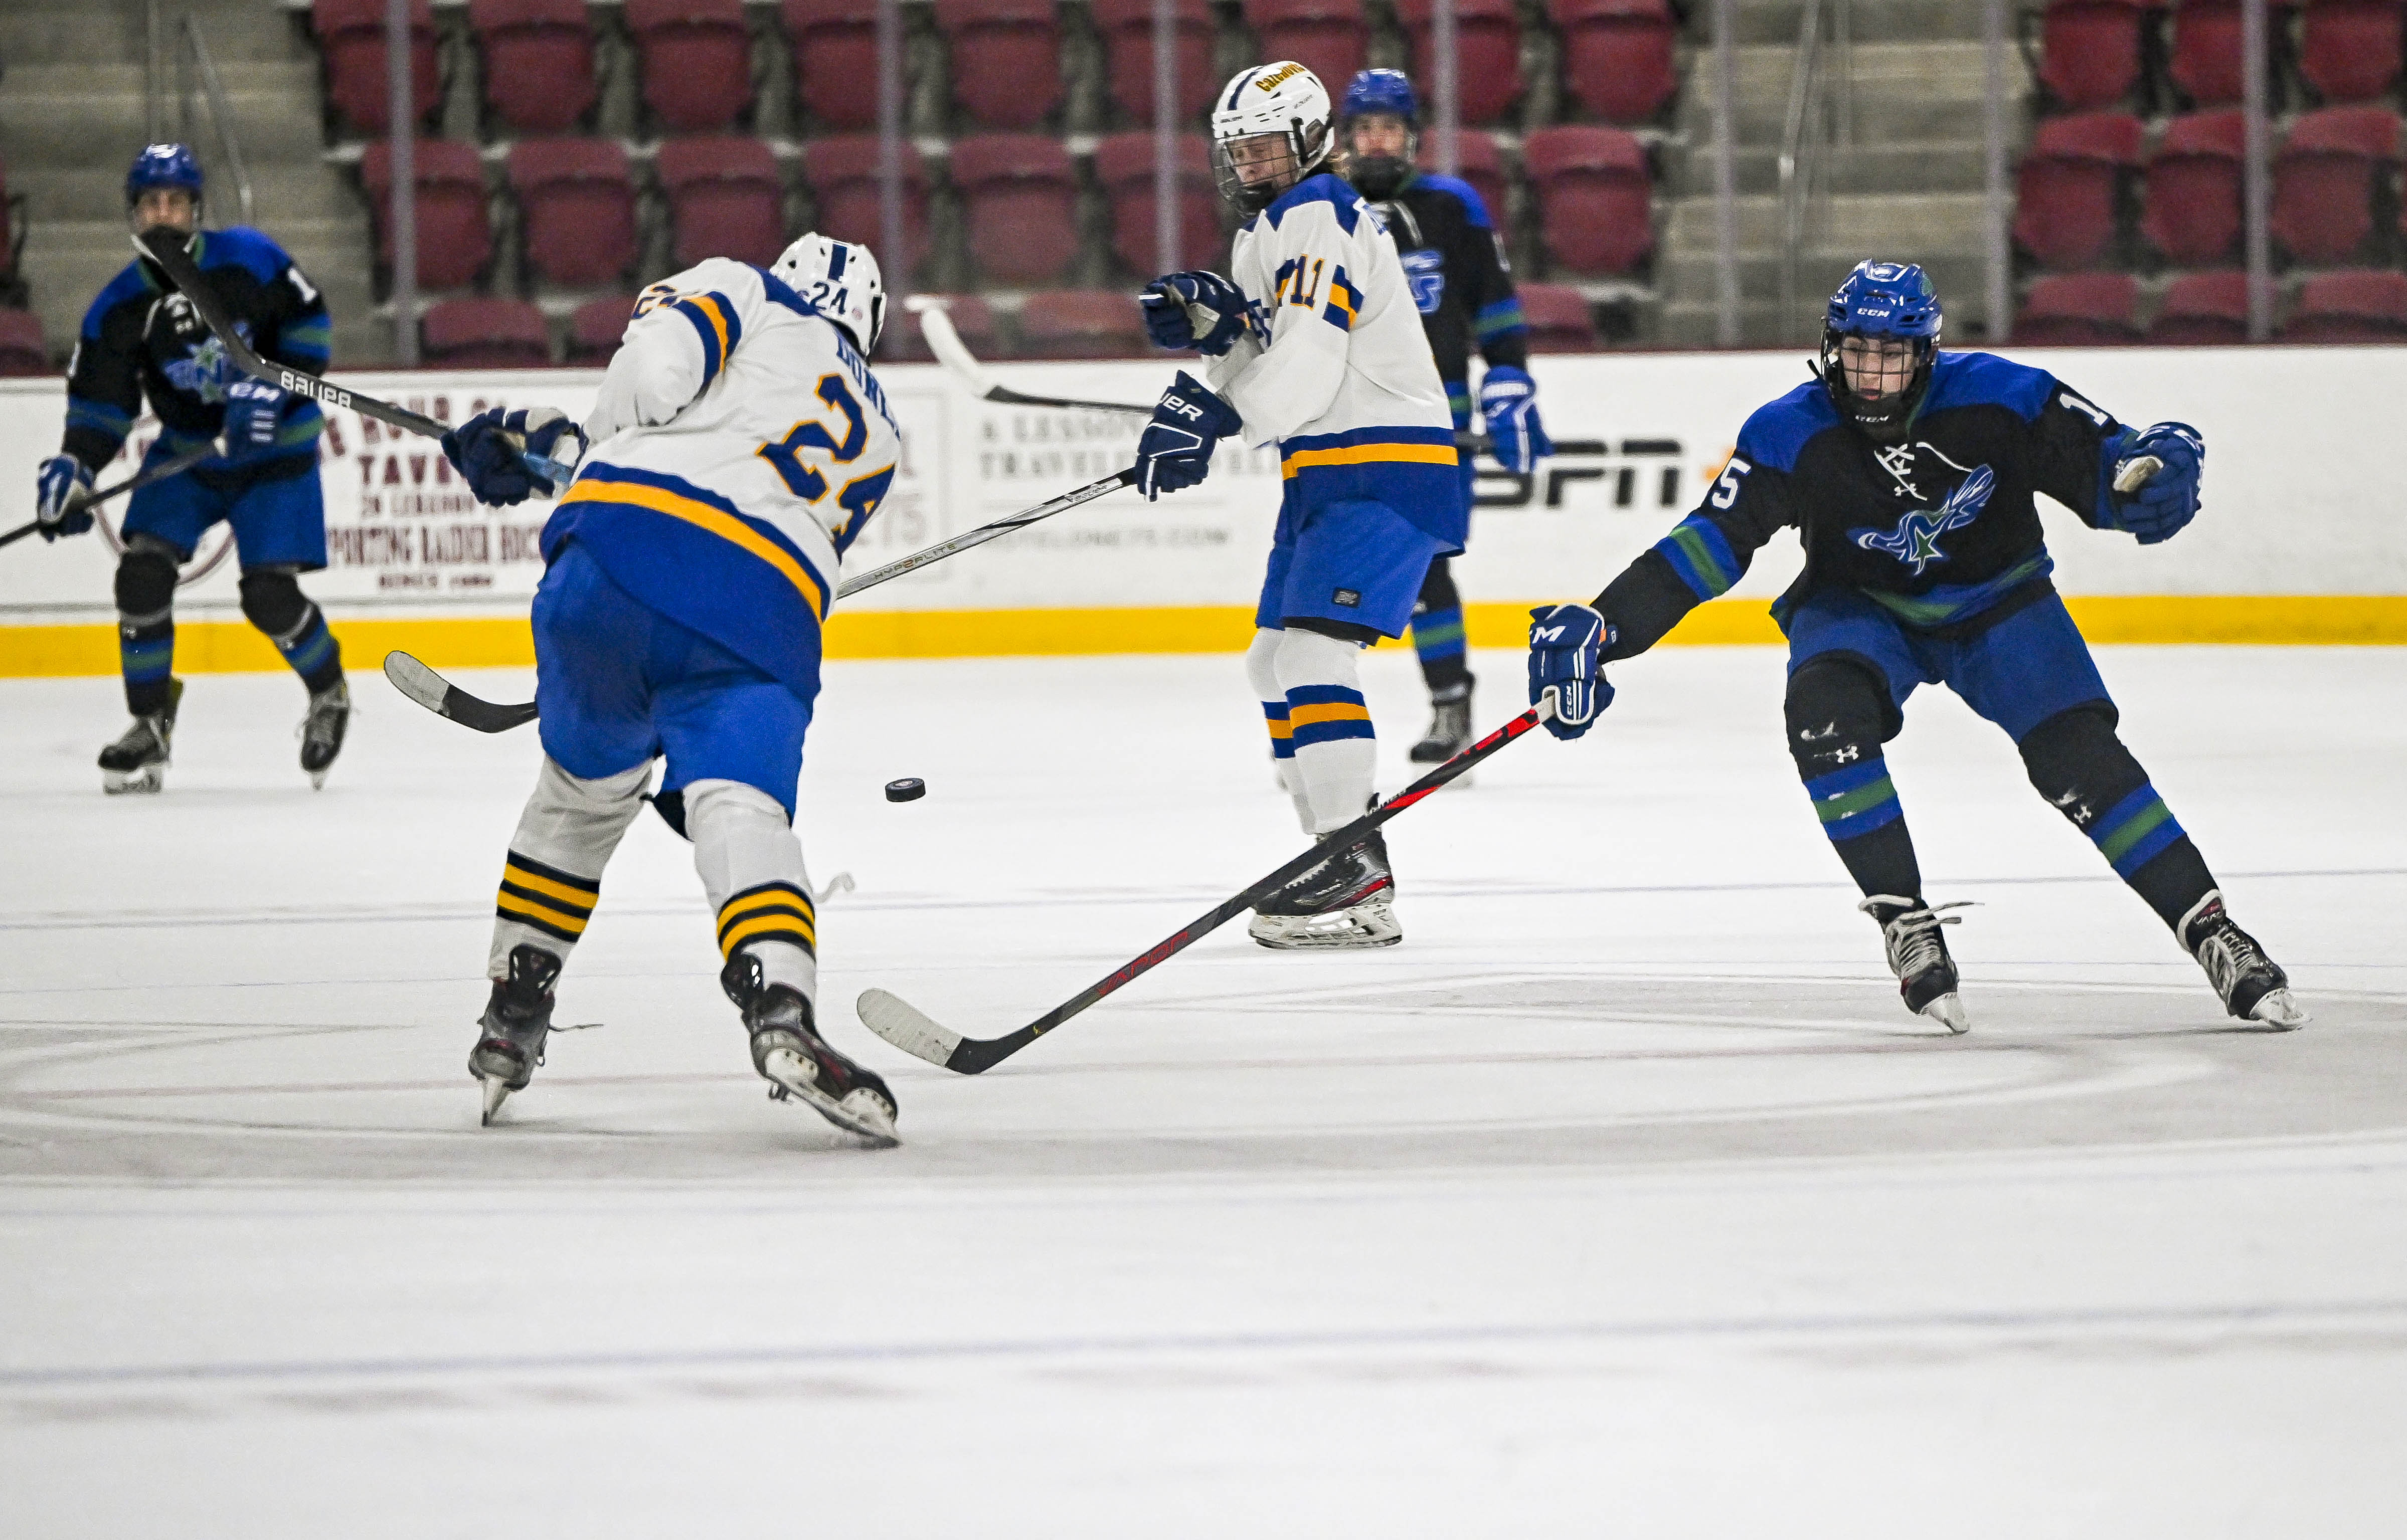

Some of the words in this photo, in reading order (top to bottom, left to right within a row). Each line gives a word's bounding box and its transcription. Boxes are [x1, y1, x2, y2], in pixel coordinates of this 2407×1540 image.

[809, 281, 848, 315] 24
[1857, 307, 1890, 317] CCM
[2059, 392, 2108, 426] 1
[1470, 440, 1681, 507] SPN
[1711, 459, 1752, 510] 5
